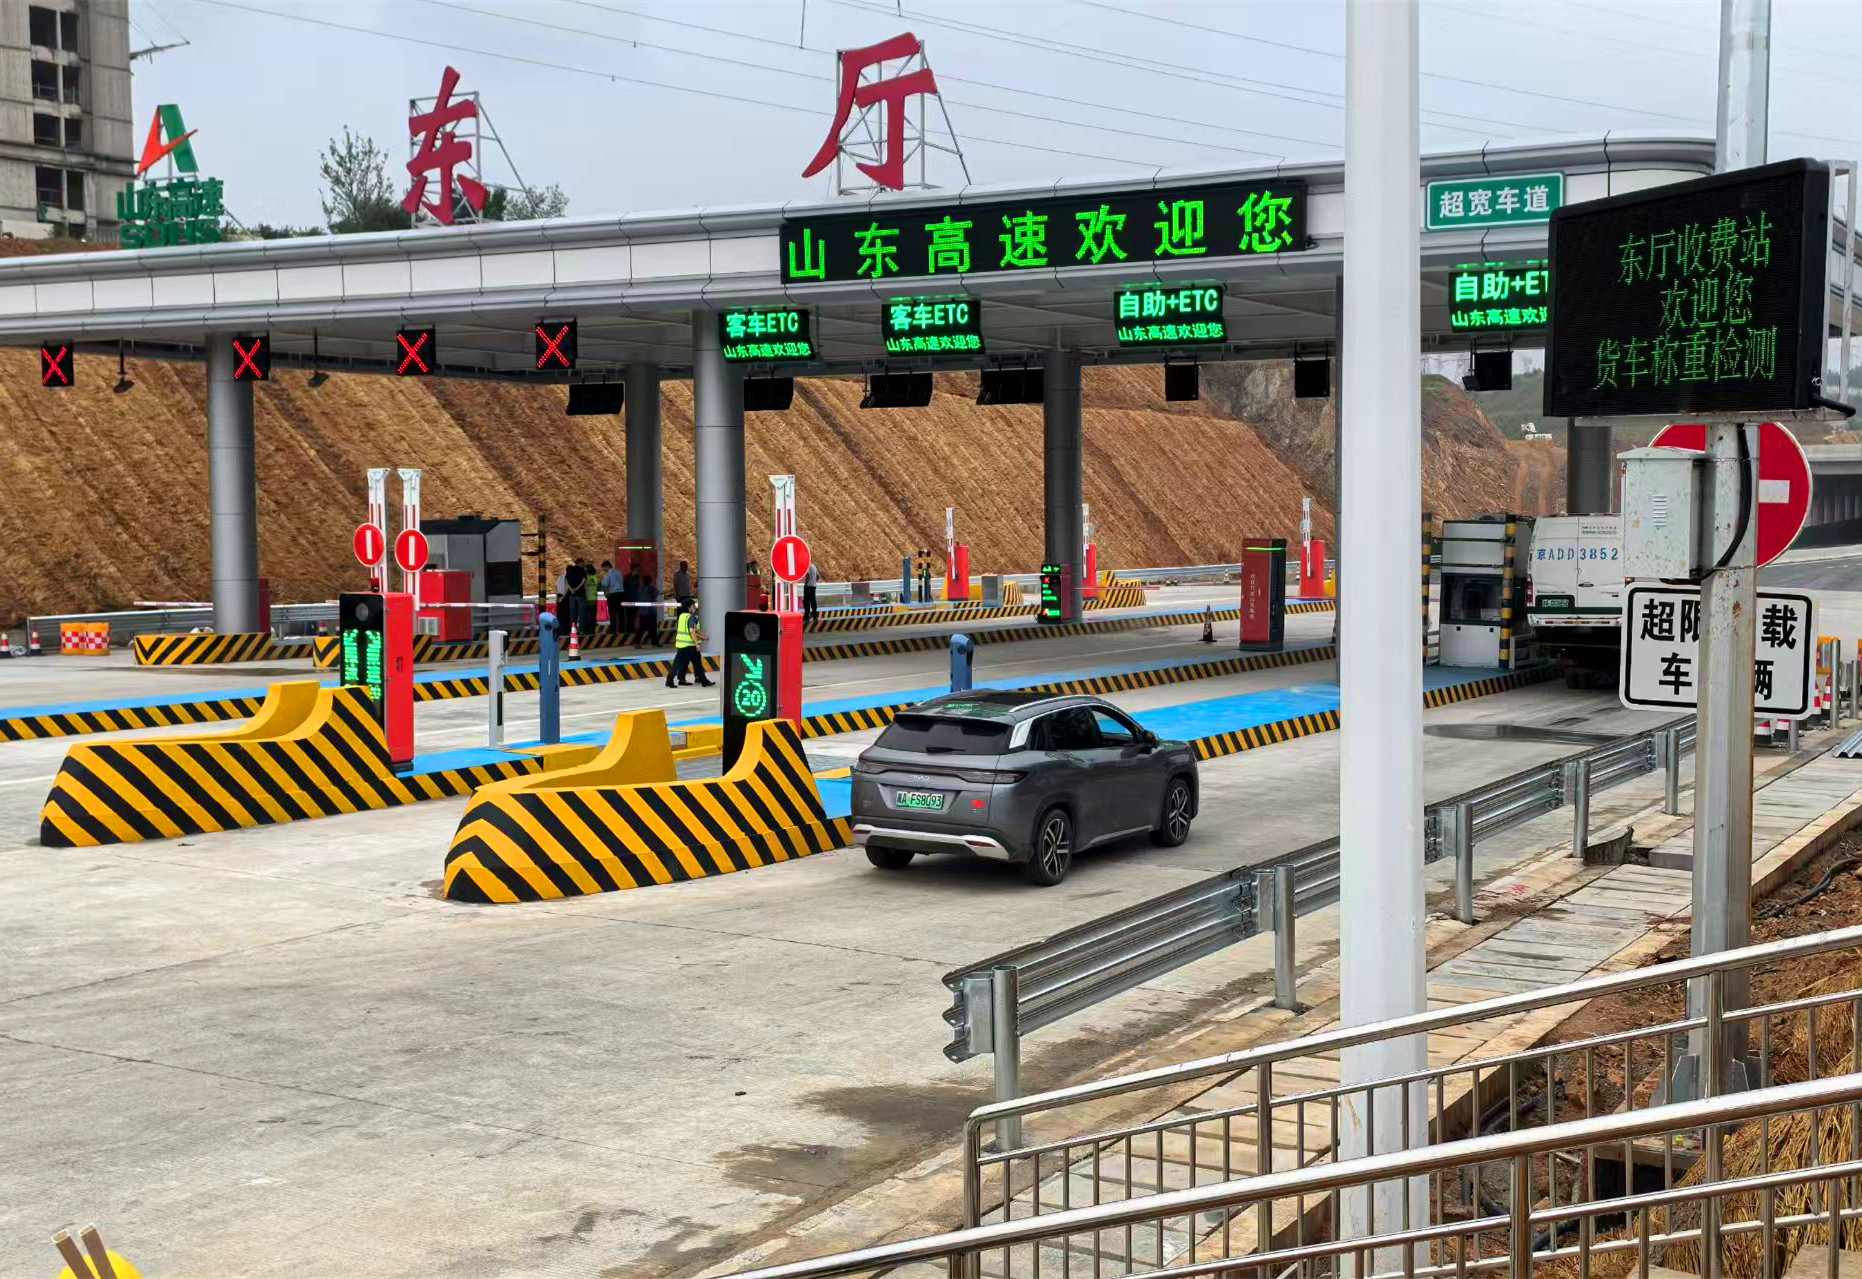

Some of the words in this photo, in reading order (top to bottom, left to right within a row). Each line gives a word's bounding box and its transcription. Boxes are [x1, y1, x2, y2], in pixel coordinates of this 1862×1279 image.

[402, 66, 488, 224] 东
[801, 32, 938, 190] 厅
[117, 177, 225, 221] 山东高速
[1438, 184, 1551, 220] 超宽车道
[788, 190, 1294, 281] 山东高速欢迎您
[1617, 210, 1773, 285] 东厅收费站
[890, 303, 970, 331] 客车ETC
[1119, 289, 1218, 319] 自助+ETC
[1659, 271, 1754, 333] 欢迎您
[726, 311, 799, 338] 客车ETC
[1118, 322, 1224, 341] 山东高速欢迎您
[723, 341, 812, 358] 山东高速欢迎您
[886, 334, 981, 352] 山东高速欢迎您
[1592, 326, 1778, 391] 货车称重检测
[1537, 547, 1618, 560] 京ADD3852
[741, 689, 761, 706] 20
